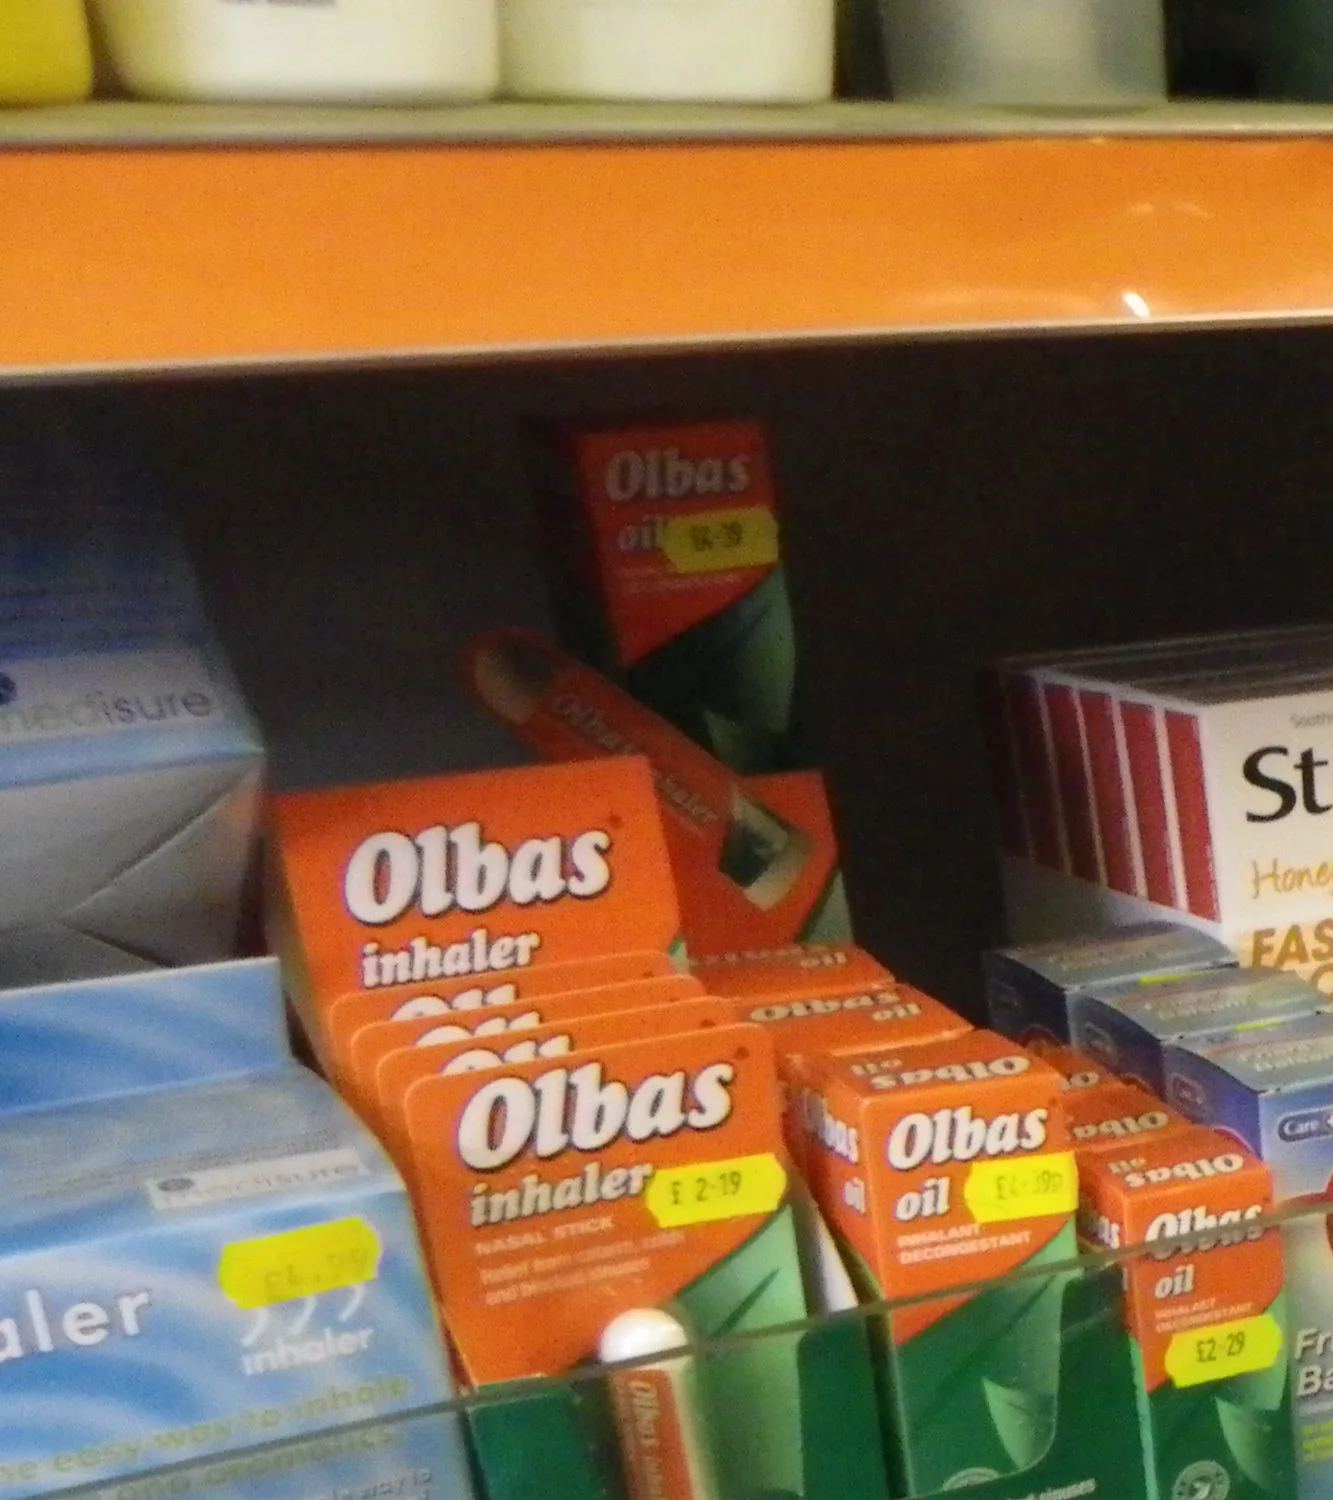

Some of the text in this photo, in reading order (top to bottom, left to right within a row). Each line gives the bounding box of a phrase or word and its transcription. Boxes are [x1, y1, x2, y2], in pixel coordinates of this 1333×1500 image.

[605, 448, 751, 501] Olbas
[342, 820, 612, 925] Olbas
[360, 929, 541, 989] inhaler
[458, 1061, 735, 1171] Olbas
[887, 1105, 1049, 1171] Olbas
[1284, 1116, 1319, 1136] Care
[469, 1162, 655, 1228] inhaler
[894, 1177, 952, 1222] oil
[897, 1224, 982, 1247] INHALANT
[899, 1230, 1032, 1265] DECONGESTANT
[1144, 1204, 1265, 1262] Olbas
[1153, 1264, 1196, 1300] oil
[242, 1328, 375, 1376] inhaler
